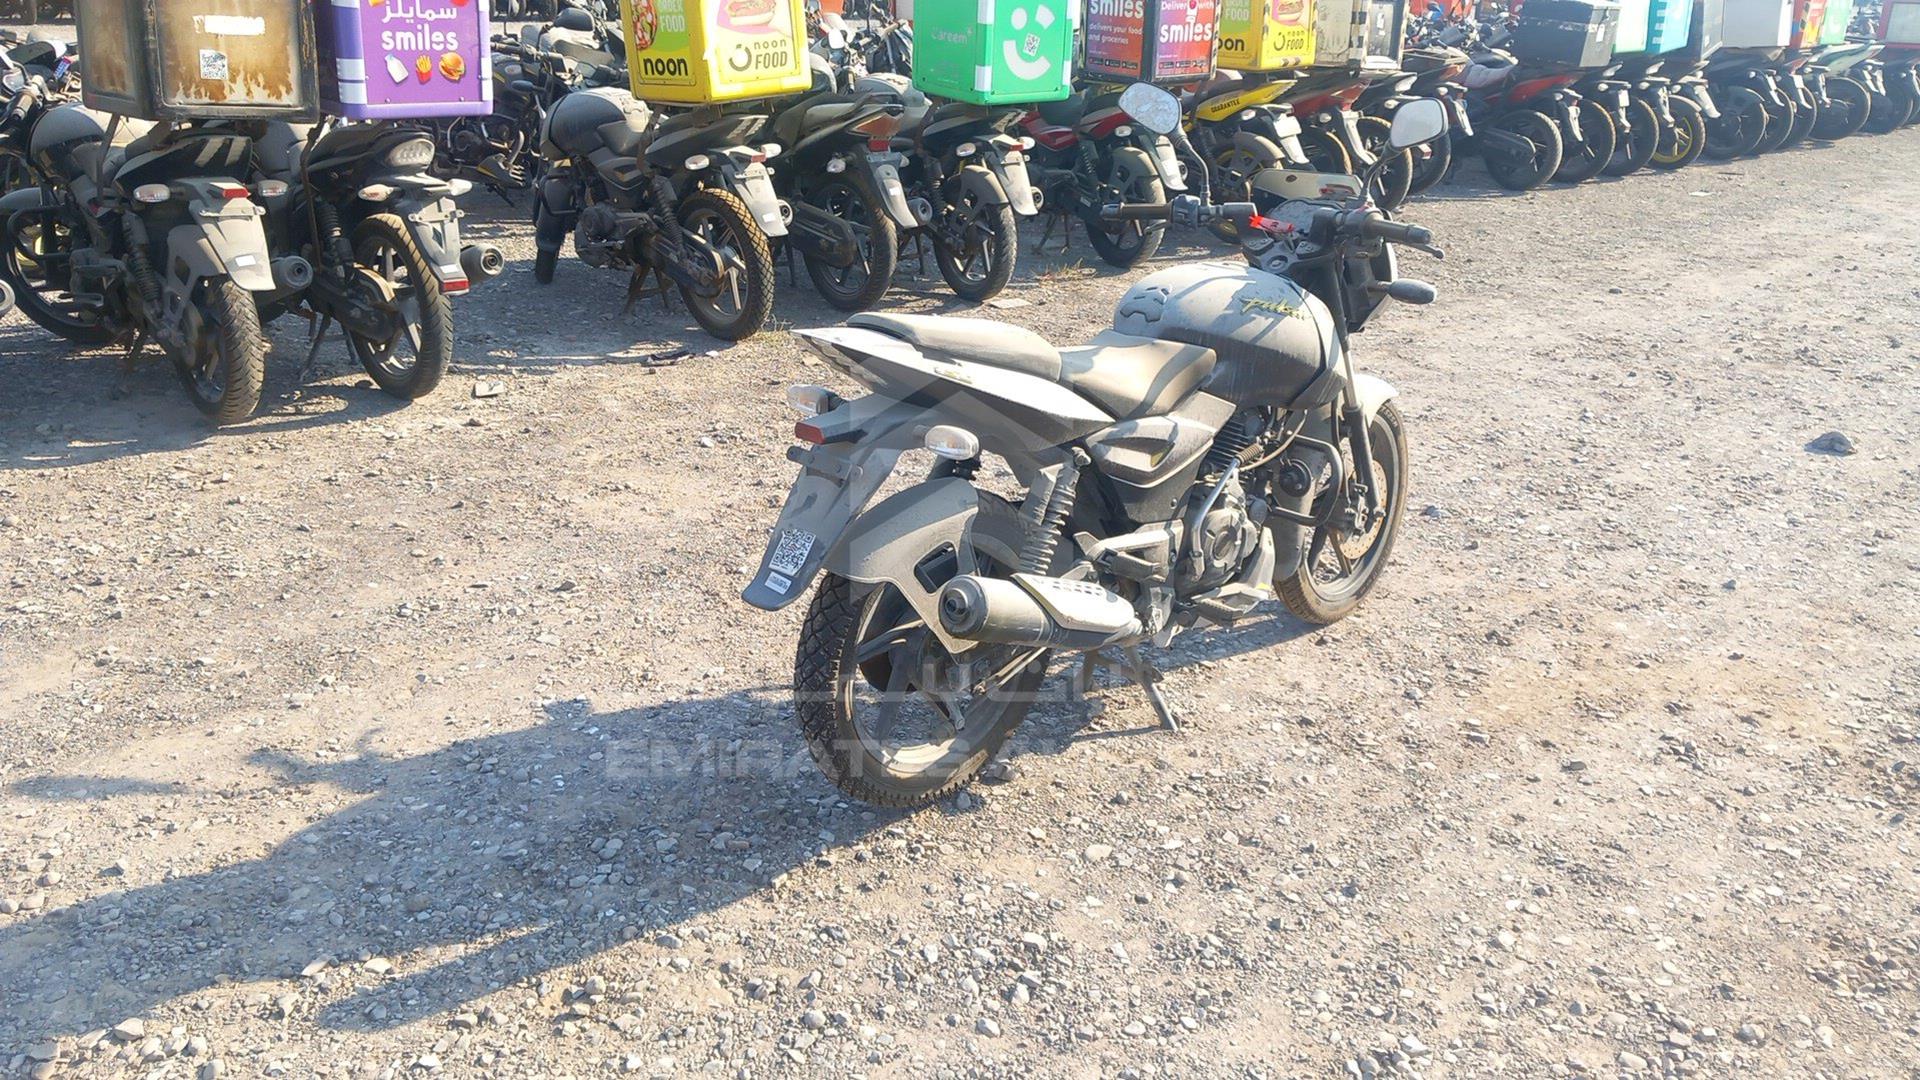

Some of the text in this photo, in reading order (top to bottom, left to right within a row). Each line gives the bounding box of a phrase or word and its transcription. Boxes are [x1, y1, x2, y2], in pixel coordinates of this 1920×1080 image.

[1090, 0, 1144, 19] smiles
[659, 15, 686, 33] FOOD
[1159, 22, 1212, 43] smiles
[381, 23, 459, 51] smiles
[754, 39, 787, 49] noon
[1286, 38, 1304, 51] FOOD
[643, 57, 688, 76] noon
[755, 51, 788, 70] FOOD
